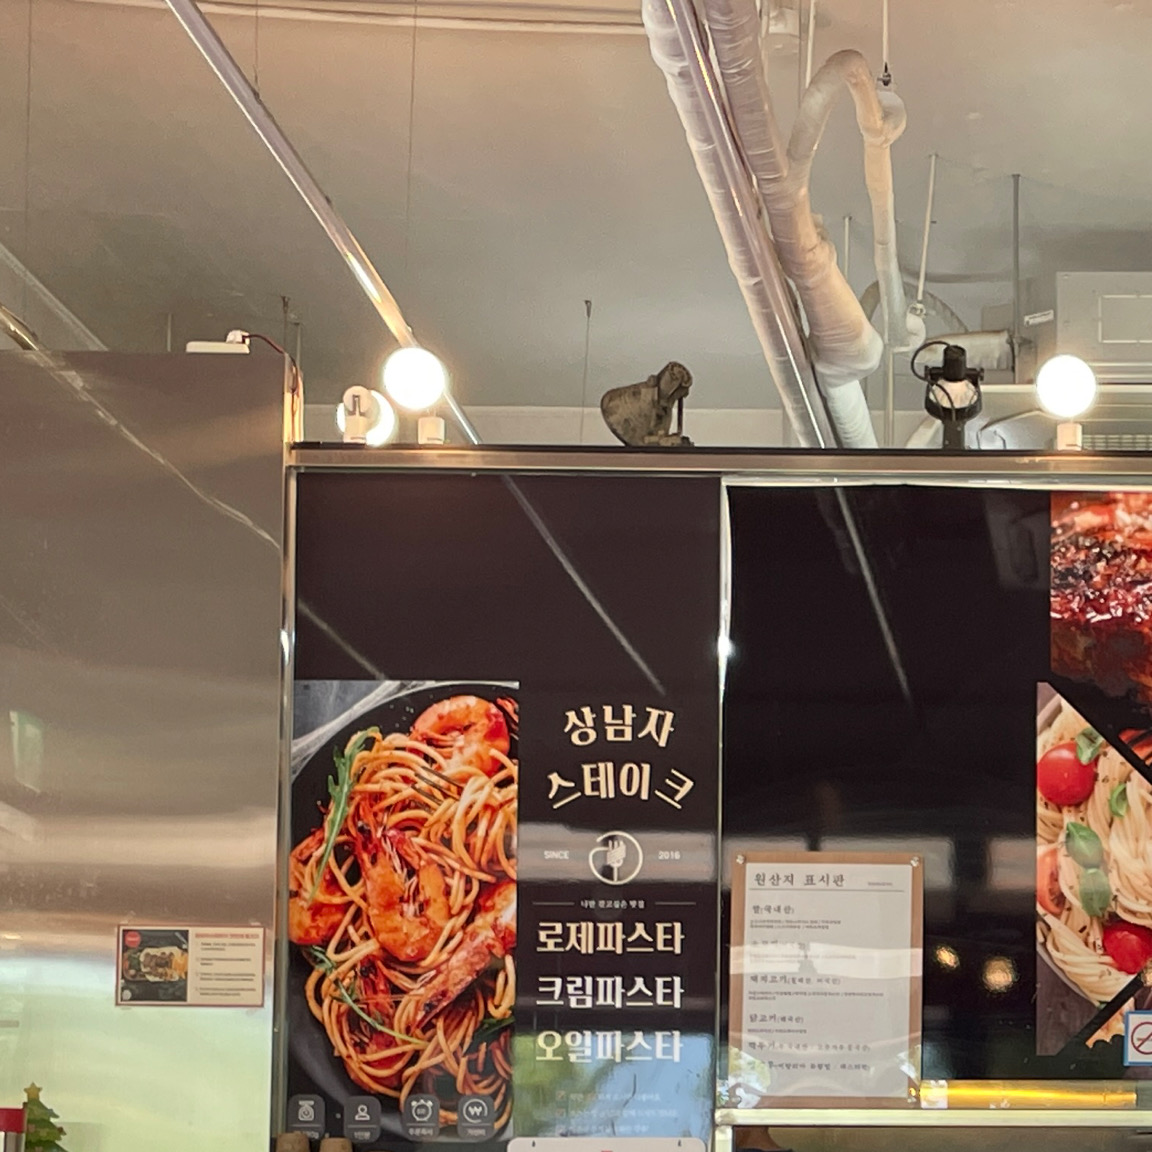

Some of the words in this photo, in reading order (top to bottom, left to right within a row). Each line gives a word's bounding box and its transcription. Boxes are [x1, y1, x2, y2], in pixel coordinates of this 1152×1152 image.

[564, 704, 675, 747] 상남자
[547, 761, 694, 809] 스테이크
[544, 850, 569, 860] SINCE
[658, 850, 680, 860] 2016
[754, 872, 794, 887] 원산지
[804, 873, 845, 887] 표시판
[536, 922, 685, 954] 로제파스타
[536, 976, 684, 1008] 크림파스타
[535, 1030, 684, 1063] 오일파스타
